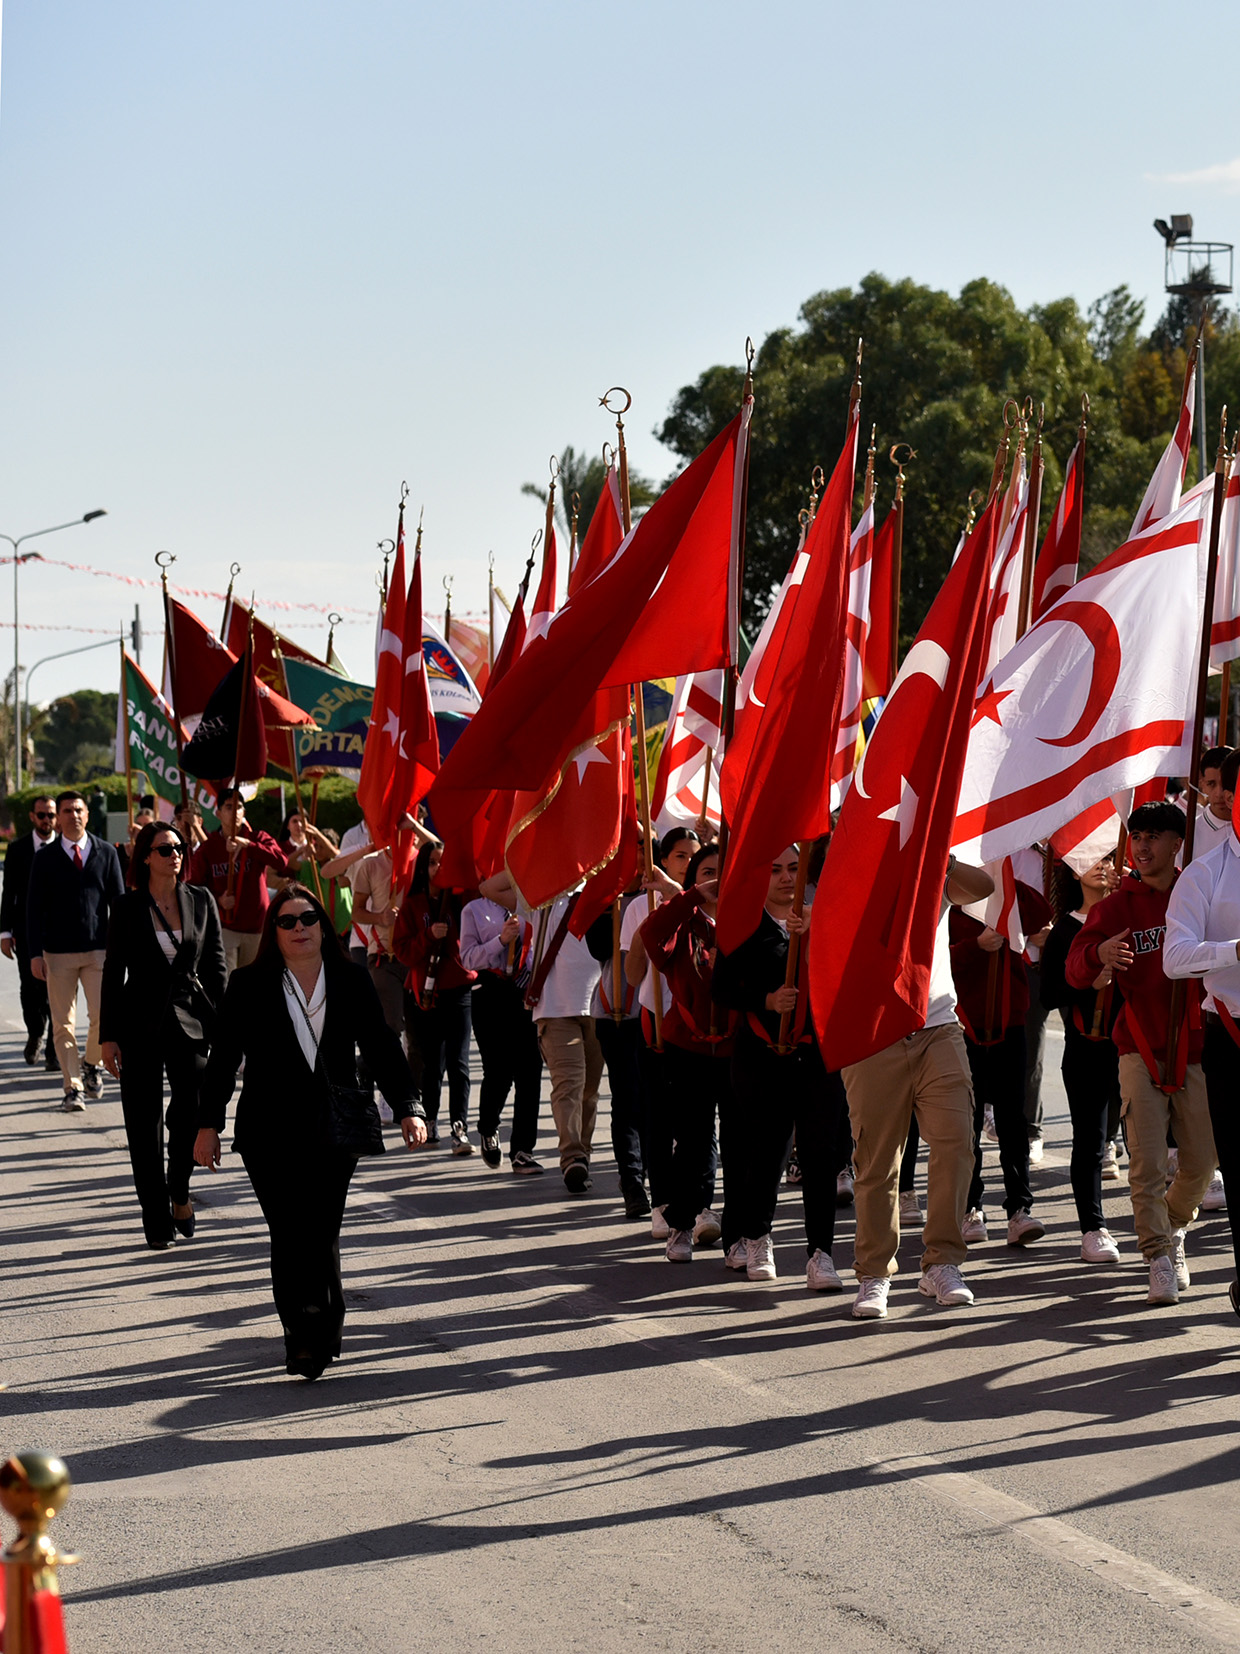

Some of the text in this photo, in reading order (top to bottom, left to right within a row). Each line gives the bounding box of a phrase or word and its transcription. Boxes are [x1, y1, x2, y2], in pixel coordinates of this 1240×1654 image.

[127, 698, 188, 750] SANV
[299, 731, 367, 757] ORTA
[129, 729, 218, 816] RTAOKU
